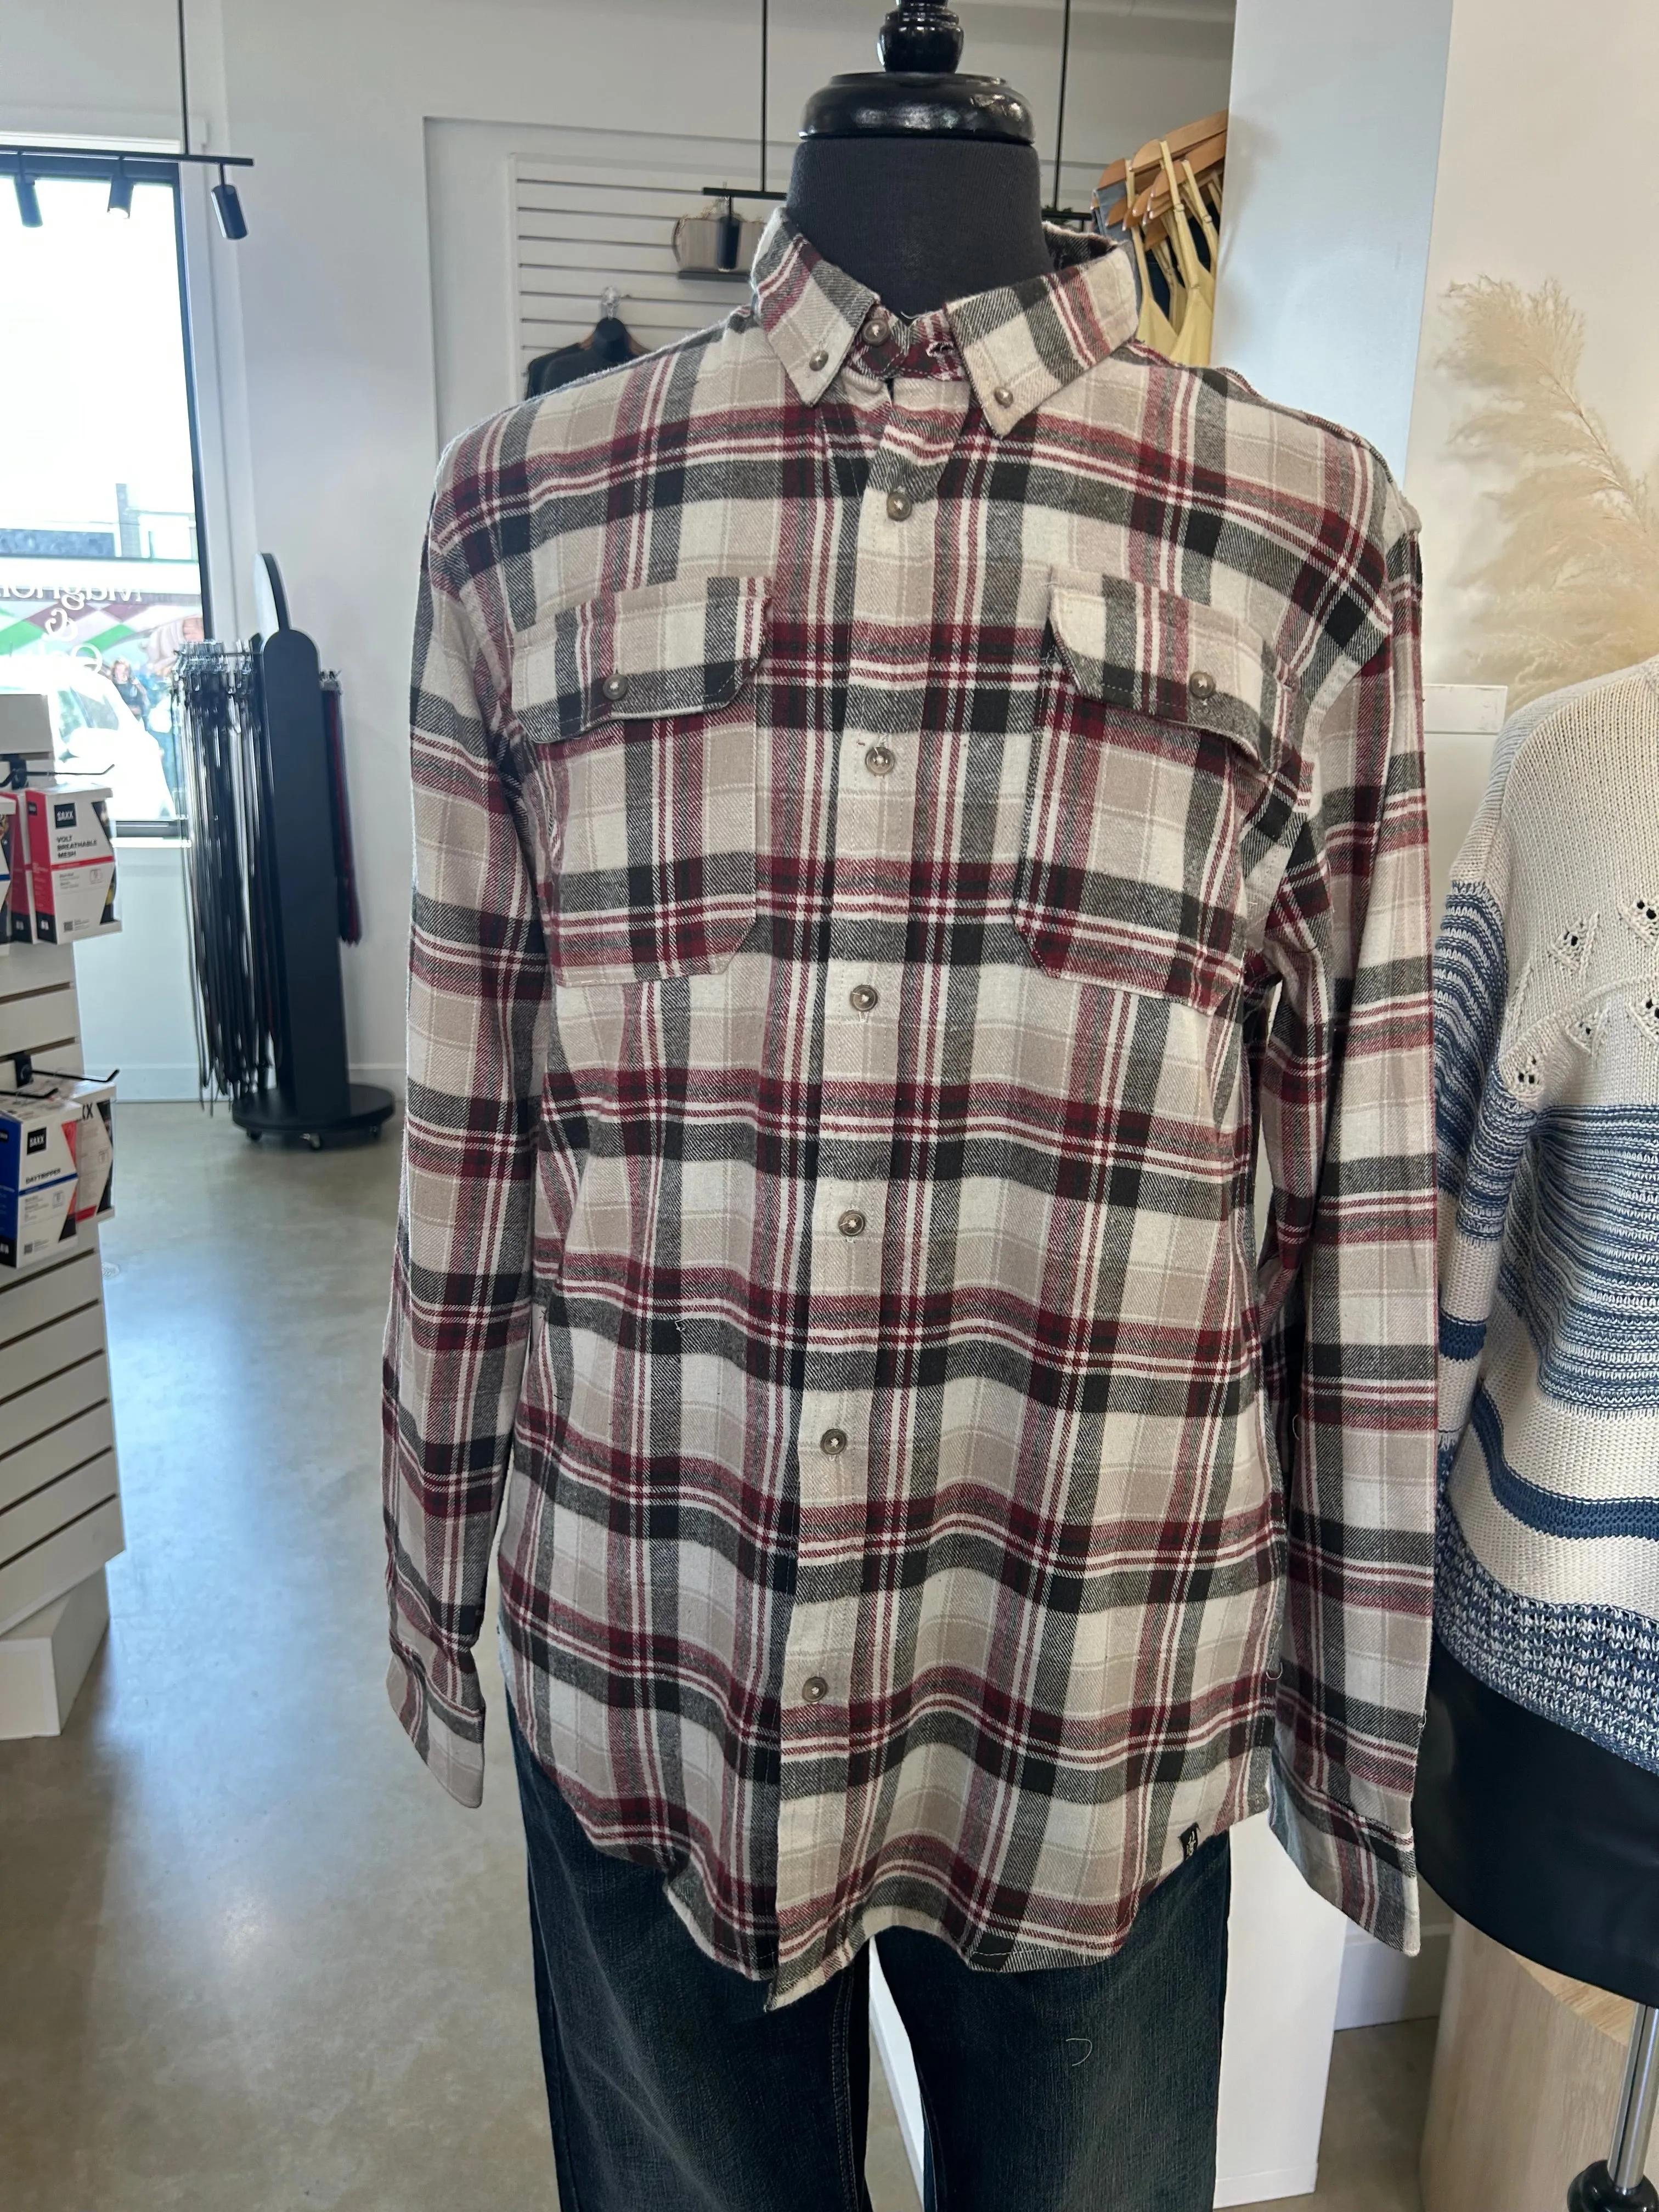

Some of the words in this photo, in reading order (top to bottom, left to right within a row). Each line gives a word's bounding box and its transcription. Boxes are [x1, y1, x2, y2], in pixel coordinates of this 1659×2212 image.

[57, 834, 72, 843] VOLT
[57, 839, 98, 851] BREATHABLE
[25, 1168, 61, 1184] DAYTRIPPER
